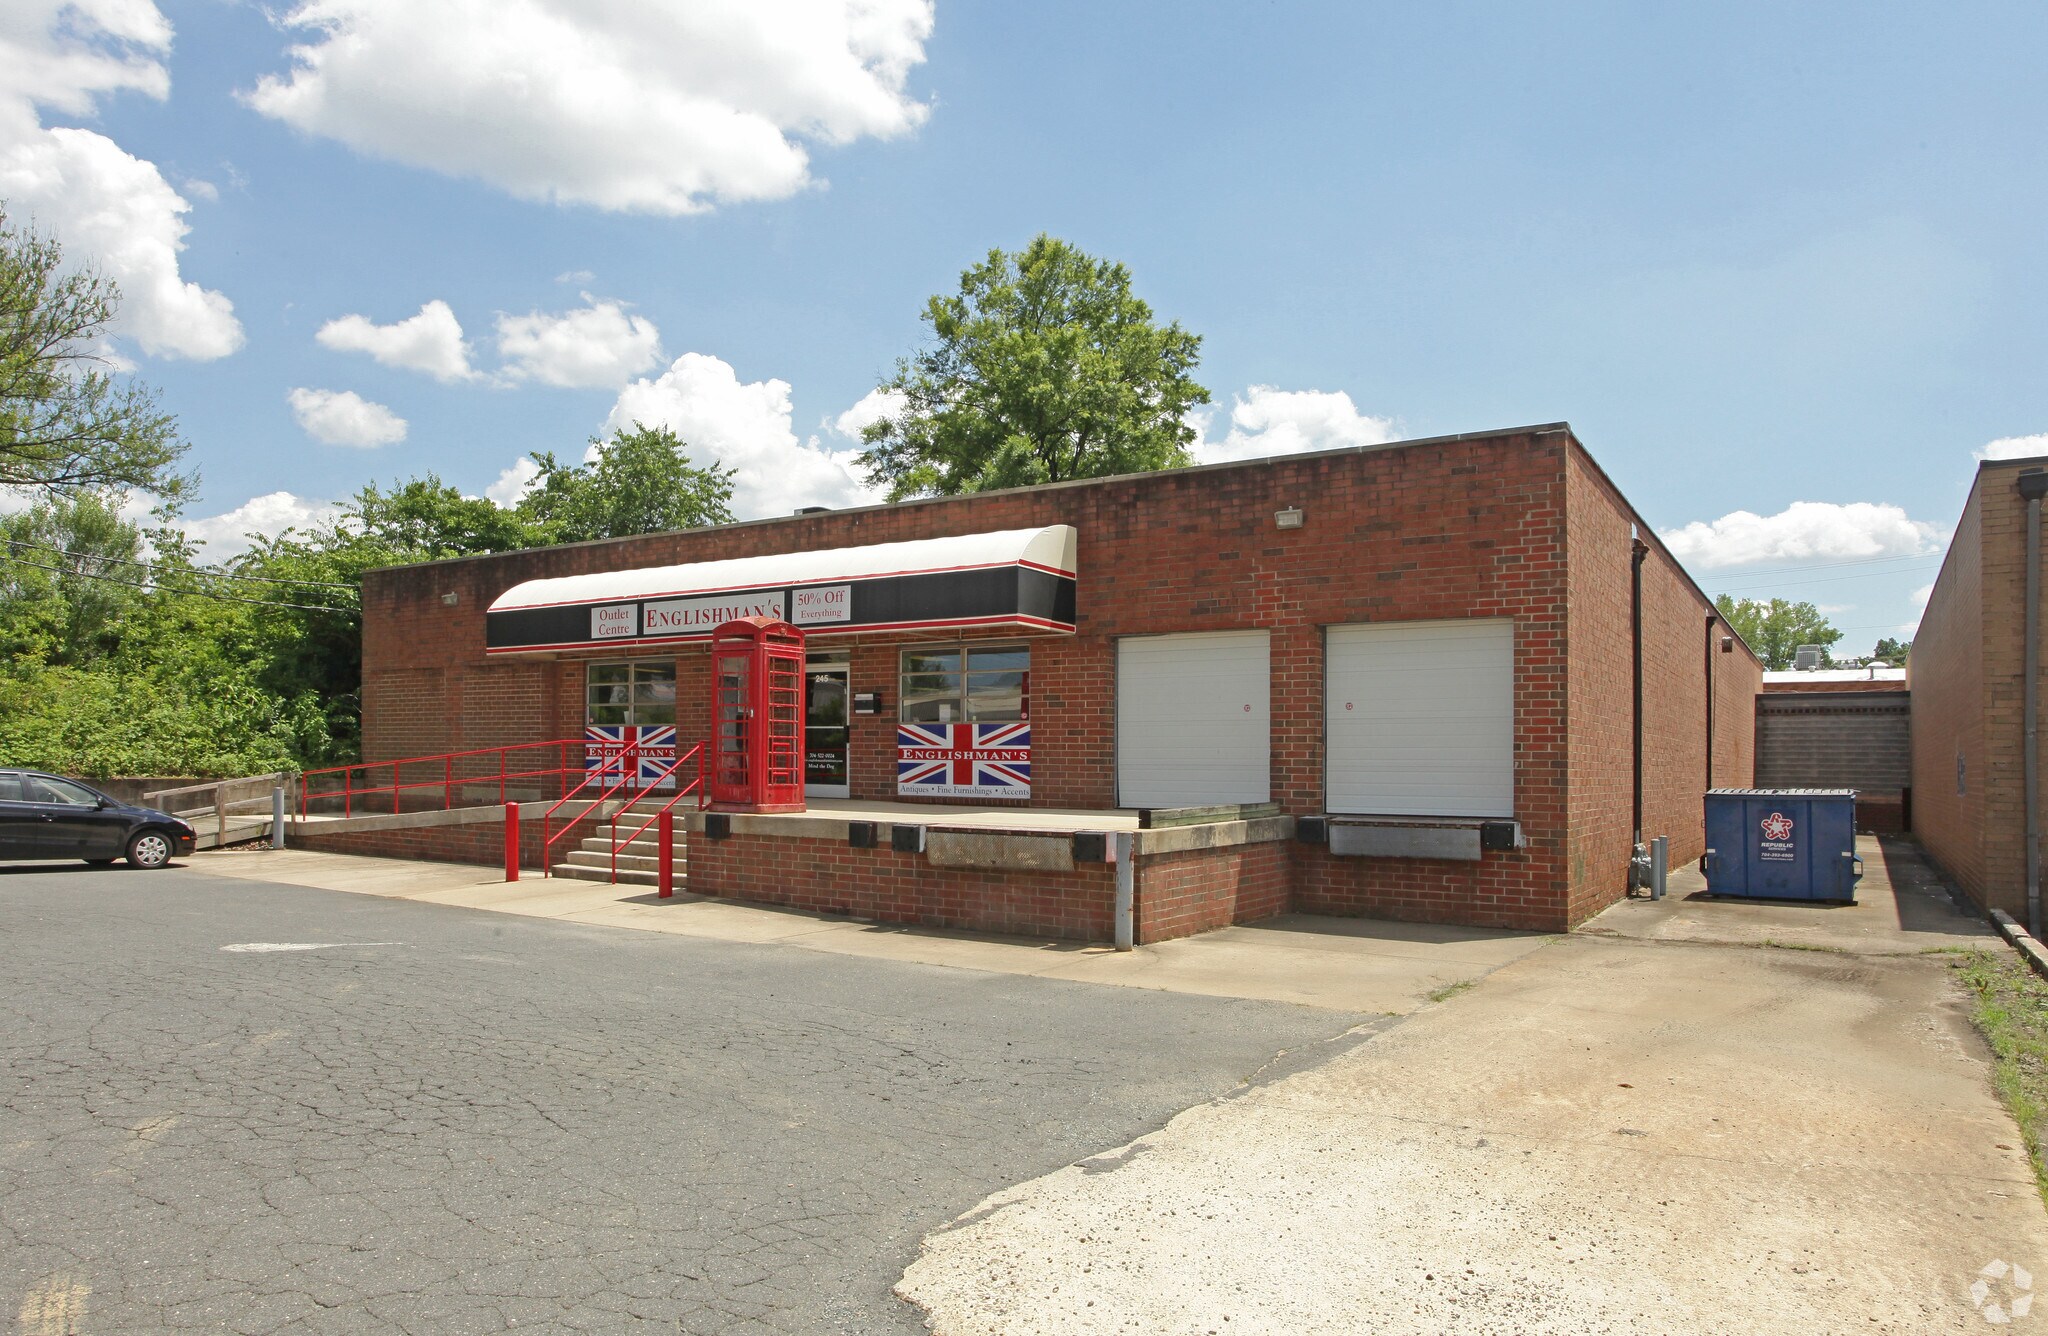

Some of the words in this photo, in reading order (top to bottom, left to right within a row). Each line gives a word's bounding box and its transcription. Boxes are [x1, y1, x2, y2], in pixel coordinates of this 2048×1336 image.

[797, 592, 821, 606] 50%
[824, 590, 845, 604] Off
[599, 608, 629, 621] Outlet
[646, 599, 781, 628] ENGLISHMAN'S
[800, 609, 842, 620] Everything
[598, 623, 630, 636] Centre
[815, 674, 829, 683] 245
[903, 749, 1028, 760] ENGLISHMAN'S
[900, 785, 929, 794] Antiques
[937, 785, 951, 794] Fine
[953, 786, 993, 796] Furnishings
[1000, 787, 1030, 797] Accents
